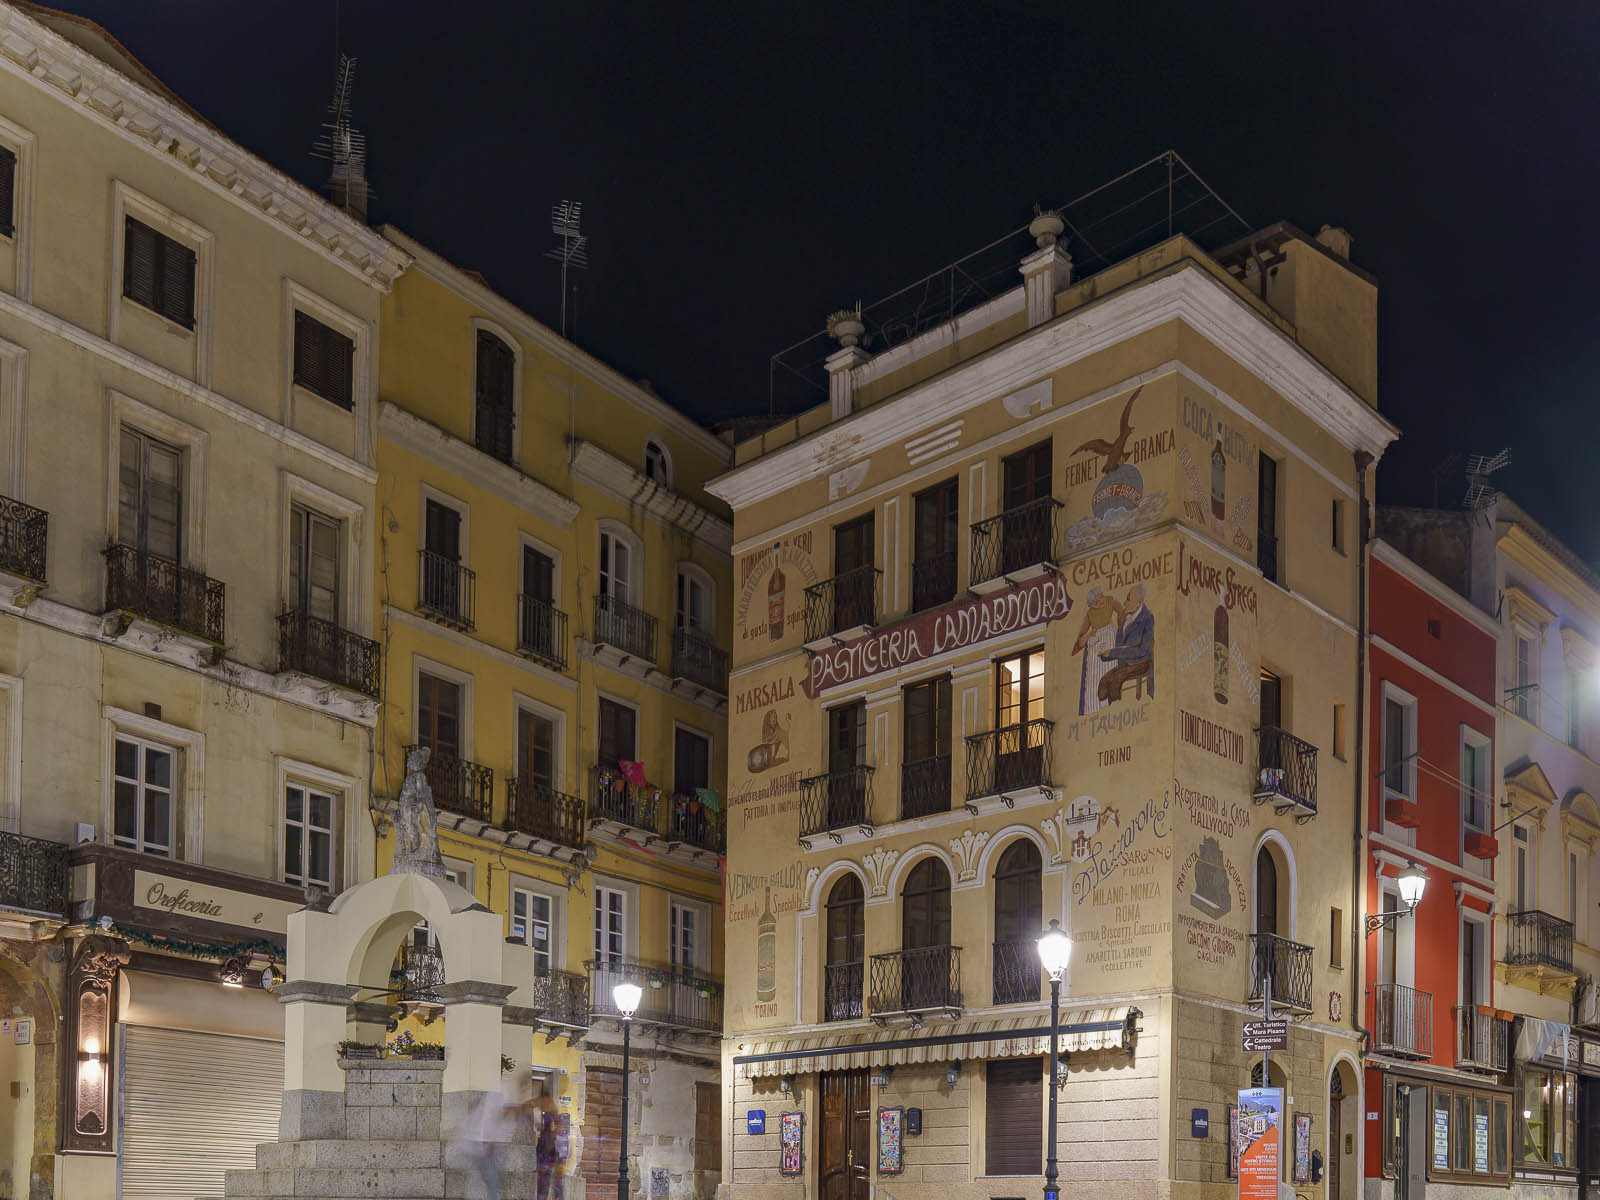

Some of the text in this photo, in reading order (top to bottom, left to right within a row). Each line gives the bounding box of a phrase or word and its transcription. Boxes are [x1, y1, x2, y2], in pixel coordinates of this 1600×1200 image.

[1065, 428, 1176, 488] FERNET BRANCA
[793, 530, 812, 554] VERO
[1072, 549, 1133, 586] CACAO
[1106, 552, 1174, 590] TALMONE
[811, 577, 1070, 697] PASTICCERIA LAMARMORA
[735, 676, 795, 714] MARSALA
[1098, 746, 1132, 768] TORINO
[1230, 803, 1250, 828] CASSA
[147, 882, 223, 914] Oreficeria
[1130, 882, 1161, 902] MONZA
[1225, 858, 1247, 912] SICUREZZA
[1115, 904, 1141, 923] ROMA
[754, 1003, 778, 1019] TORINO
